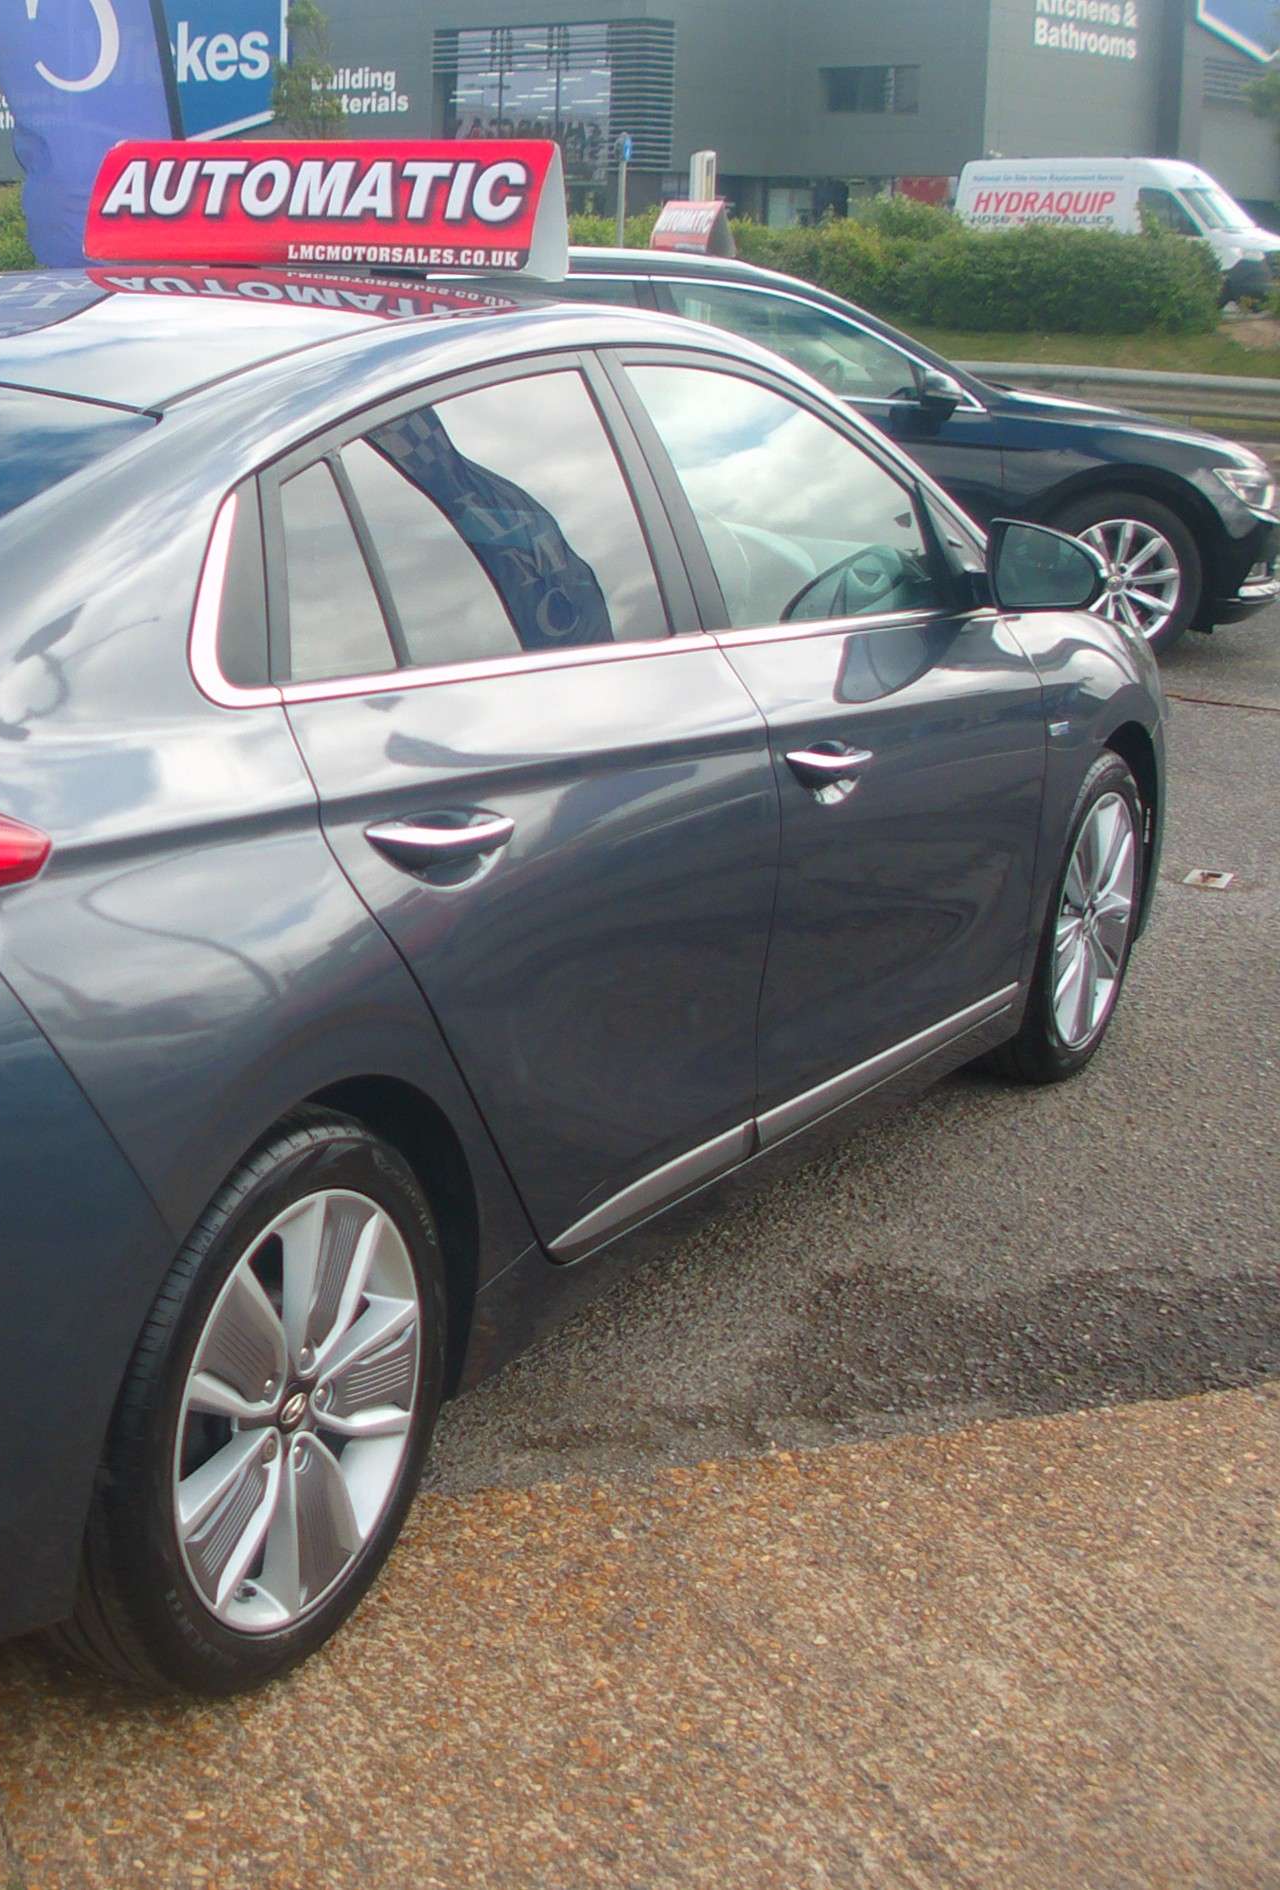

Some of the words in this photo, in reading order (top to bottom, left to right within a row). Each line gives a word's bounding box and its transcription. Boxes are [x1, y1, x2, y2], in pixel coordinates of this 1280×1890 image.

[170, 21, 270, 82] kes
[1034, 16, 1137, 59] Bathrooms
[312, 91, 409, 114] terials
[101, 159, 526, 222] AUTOMATIC
[973, 190, 1116, 215] HYDRAQUIP
[288, 244, 519, 268] LMCMOTORSALES.CO.UK
